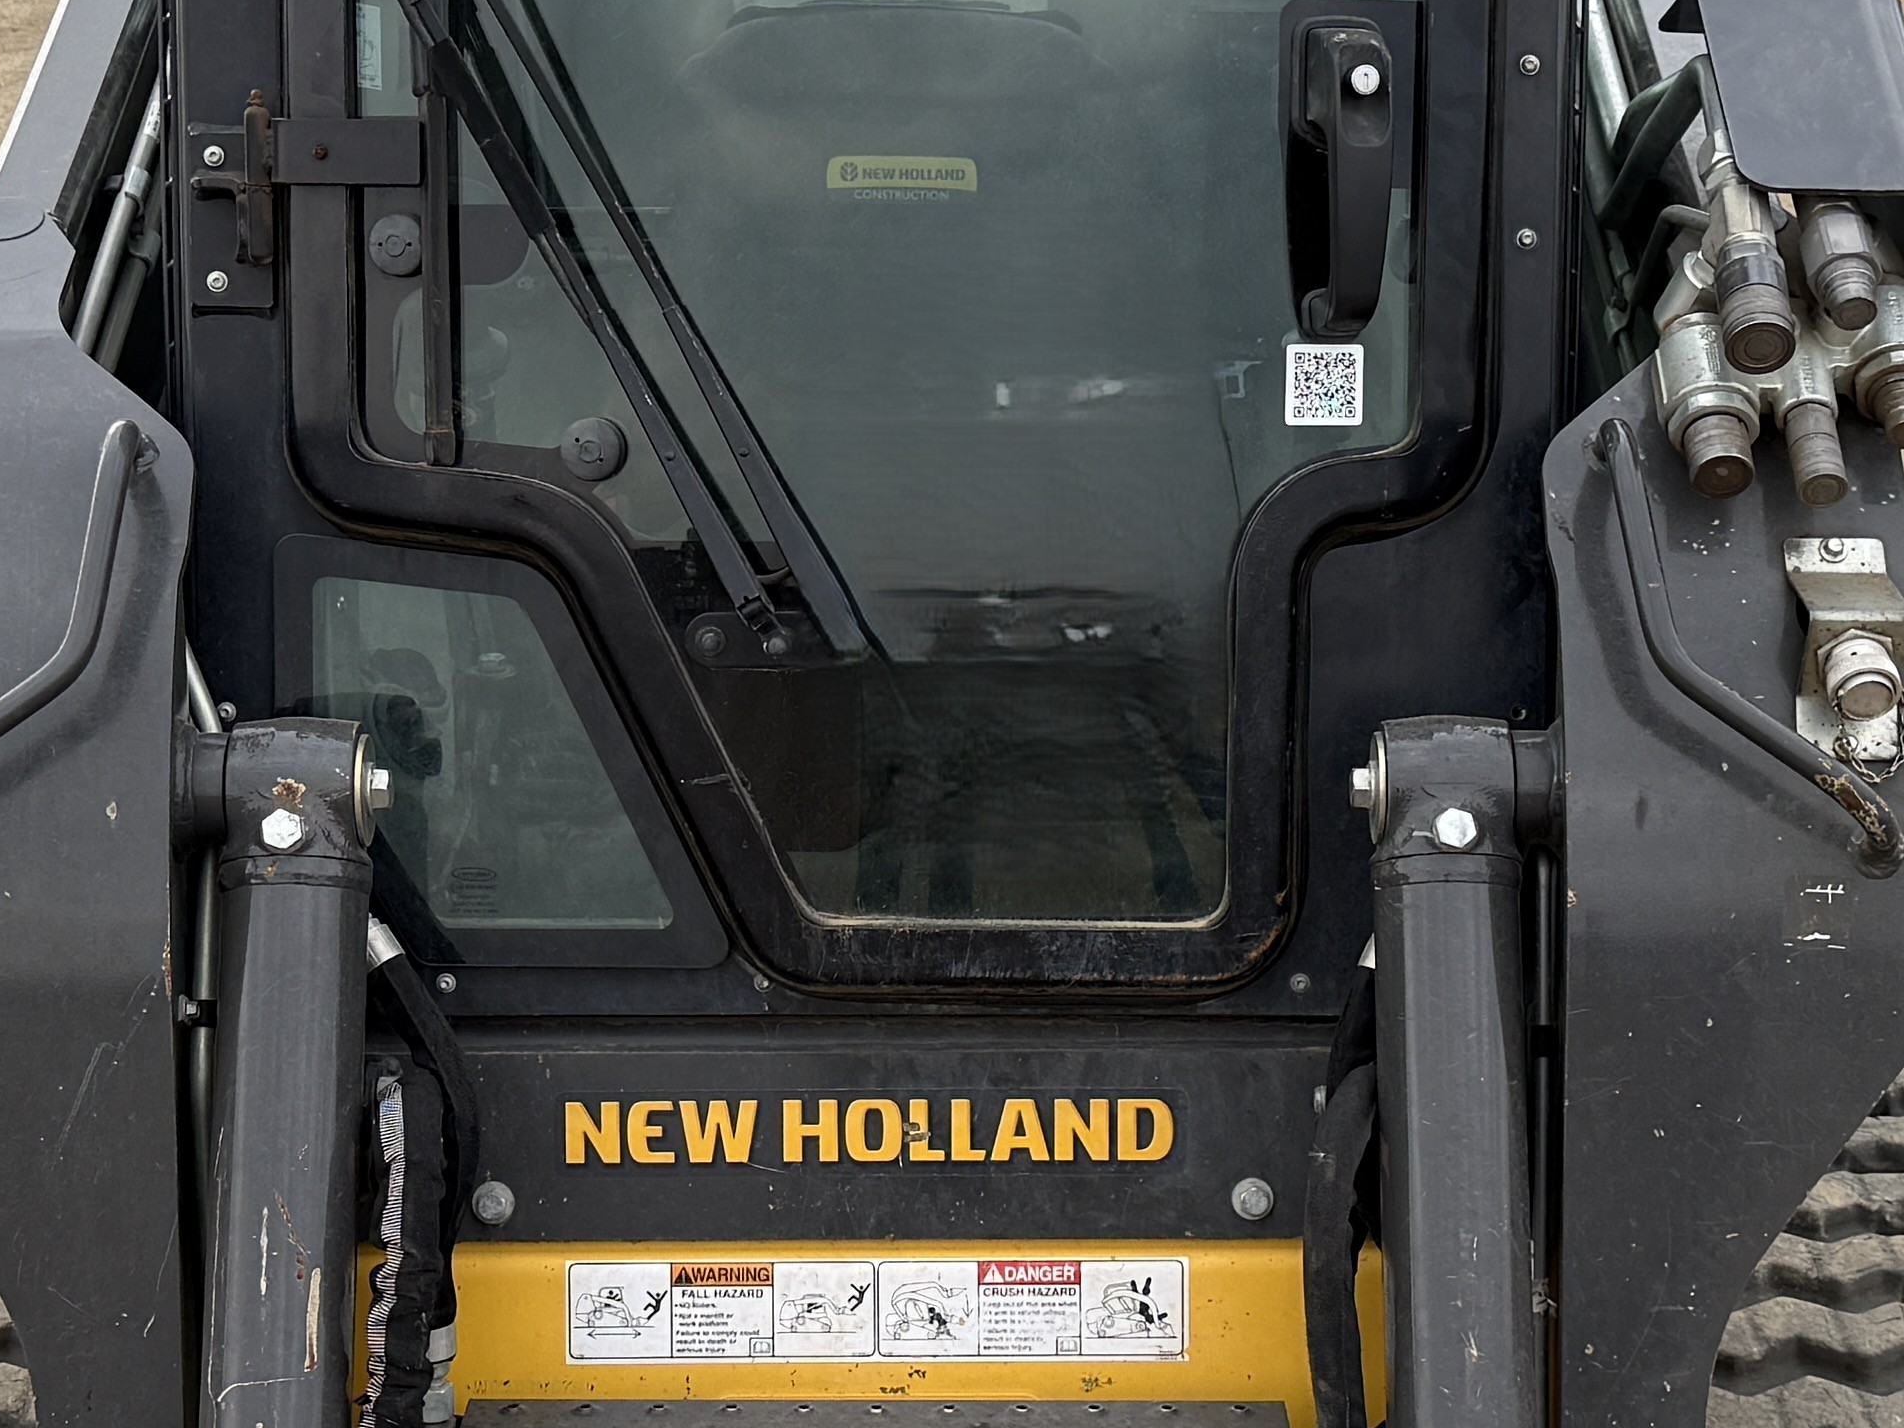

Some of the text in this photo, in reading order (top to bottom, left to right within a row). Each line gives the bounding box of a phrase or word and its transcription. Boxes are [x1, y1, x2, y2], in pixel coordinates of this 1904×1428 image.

[862, 168, 965, 181] NEW HOLLAND
[853, 189, 949, 200] CONSTRUCTION
[564, 1097, 1174, 1165] NEW HOLLAND
[691, 1267, 770, 1283] WARNING
[1004, 1266, 1075, 1282] DANGER
[681, 1288, 764, 1299] FALL HAZARD
[983, 1287, 1077, 1297] CRUSH HAZARD
